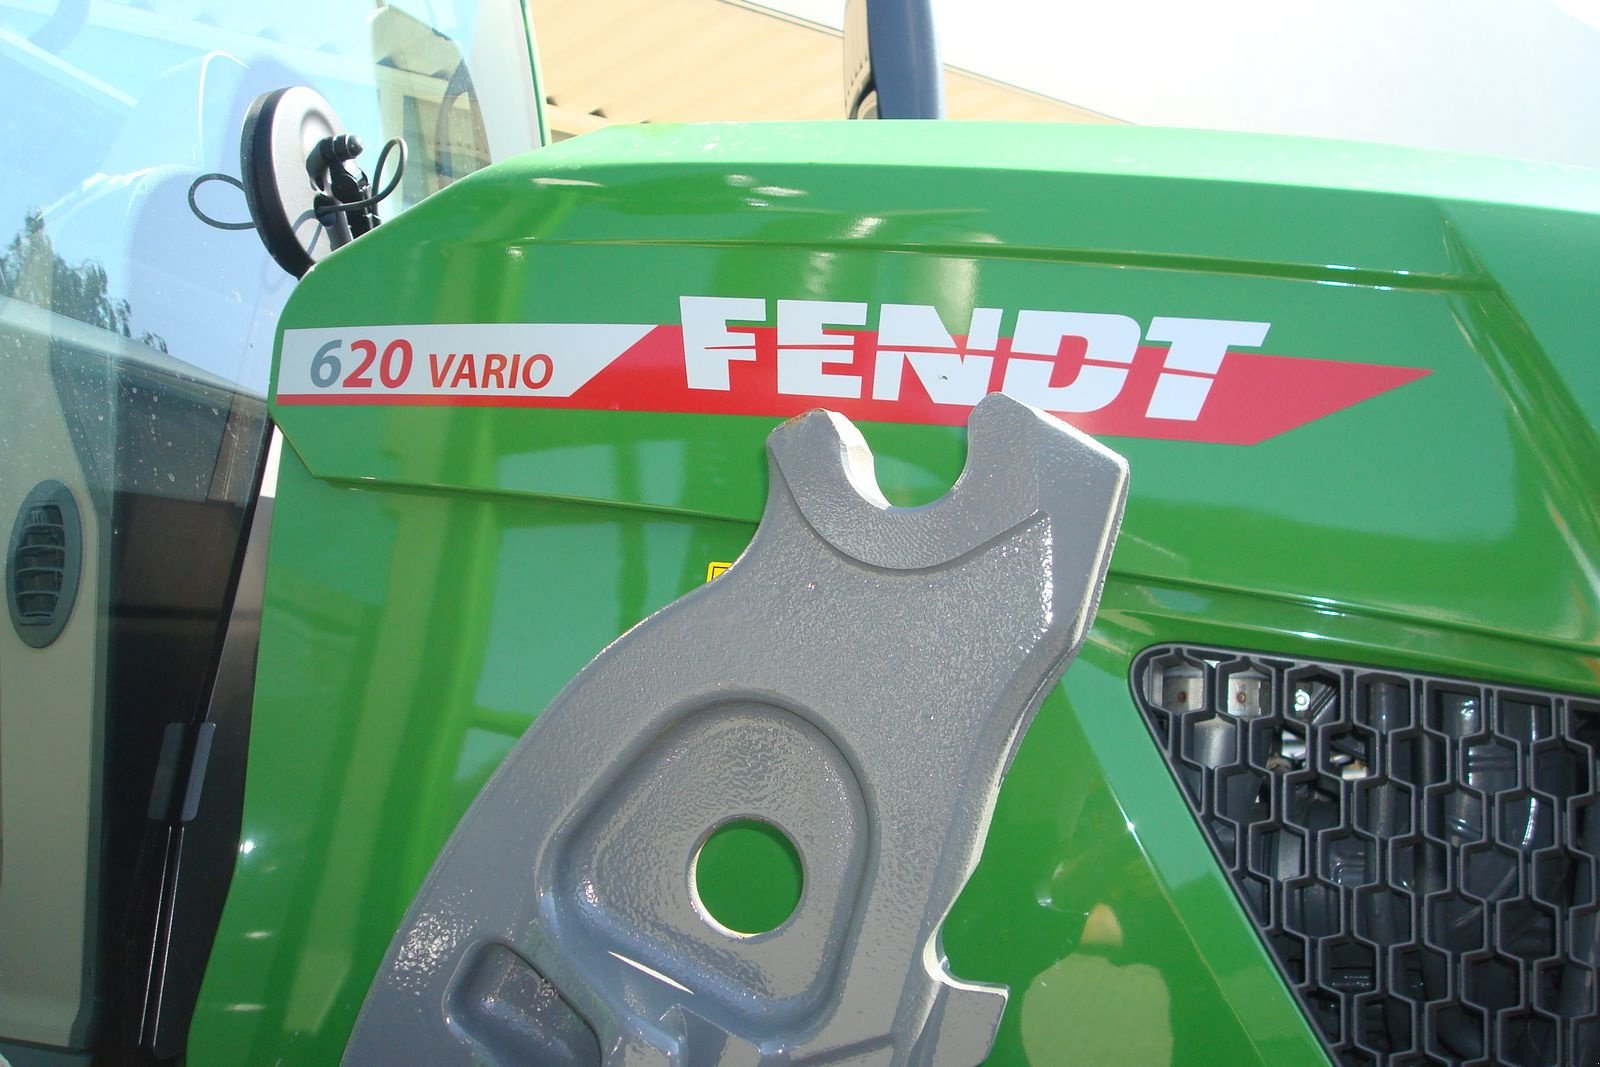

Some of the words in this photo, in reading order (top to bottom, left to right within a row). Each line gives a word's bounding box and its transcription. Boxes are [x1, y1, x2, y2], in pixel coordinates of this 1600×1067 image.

[310, 339, 413, 388] 620
[429, 353, 554, 390] VARIO
[680, 296, 1271, 421] FENDT
